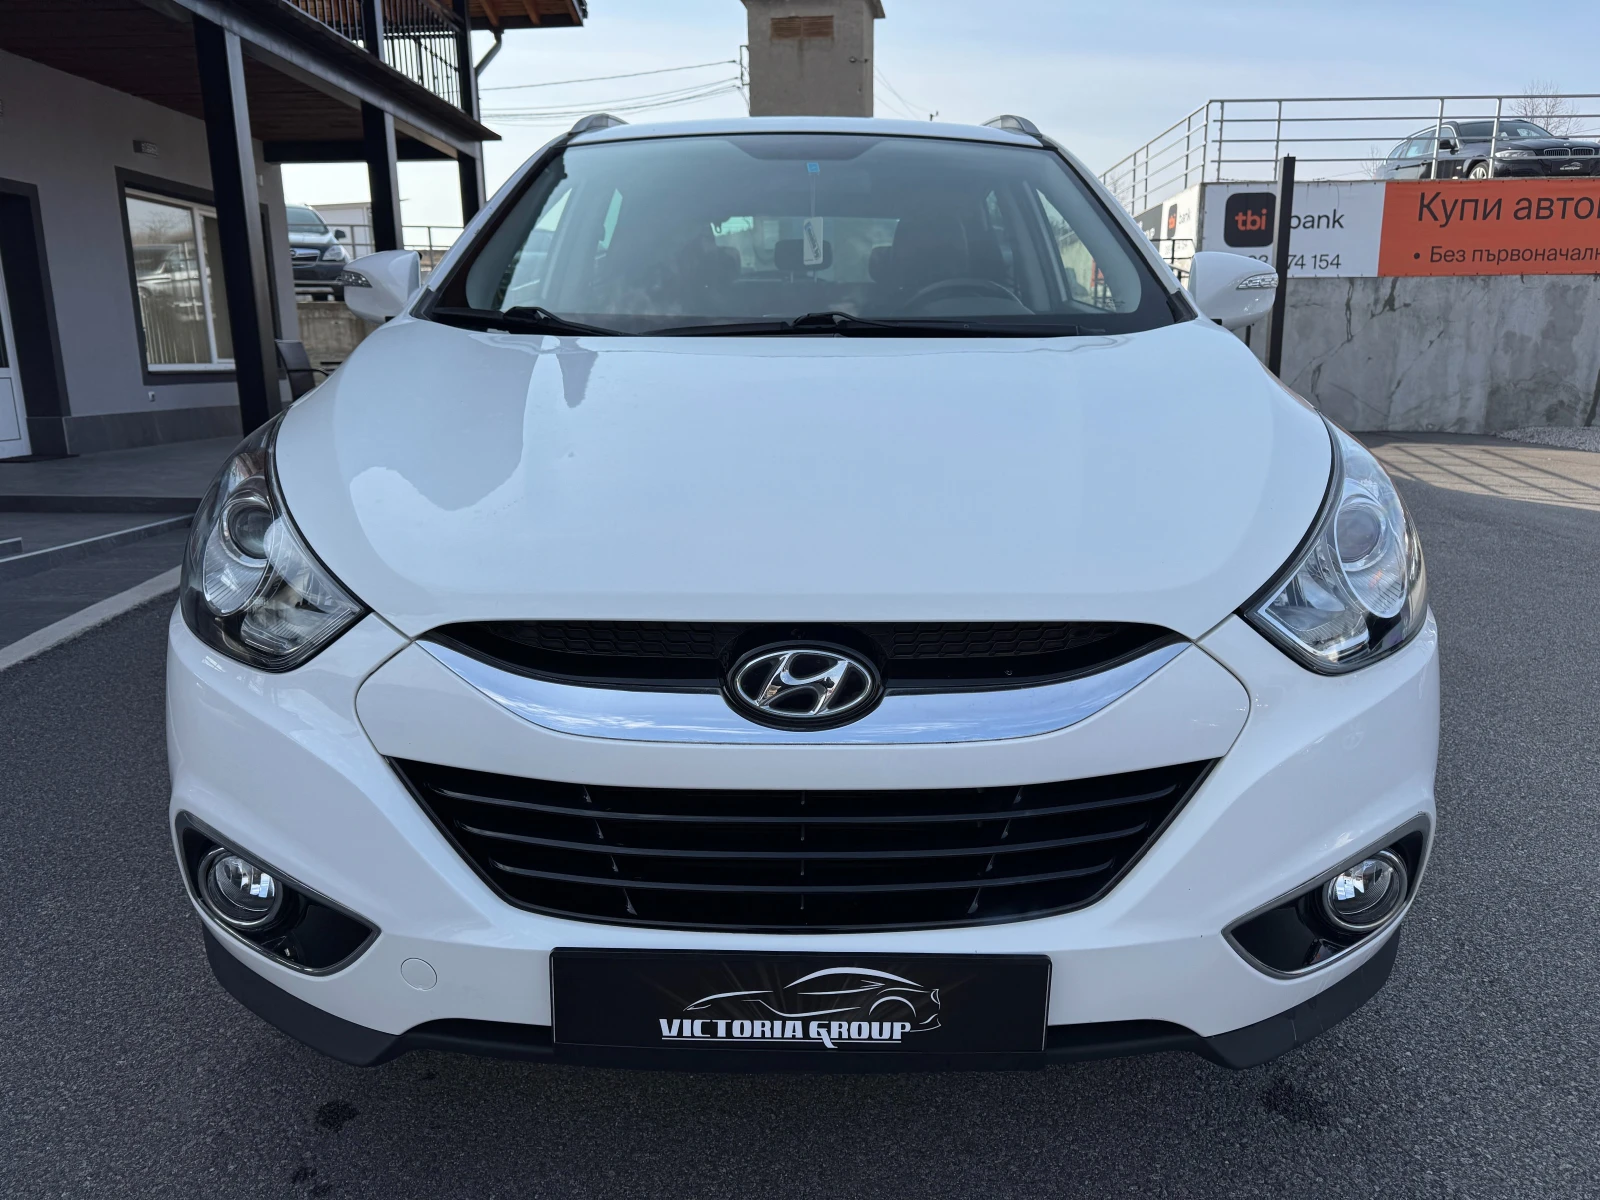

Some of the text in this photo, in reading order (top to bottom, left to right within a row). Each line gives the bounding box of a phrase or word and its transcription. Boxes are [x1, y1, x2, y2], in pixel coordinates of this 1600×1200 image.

[1234, 208, 1268, 231] tbi
[1418, 191, 1600, 228] Купи авто
[1311, 254, 1342, 270] 154
[1430, 245, 1466, 263] Без
[659, 1018, 912, 1049] VICTORIA GROUP
